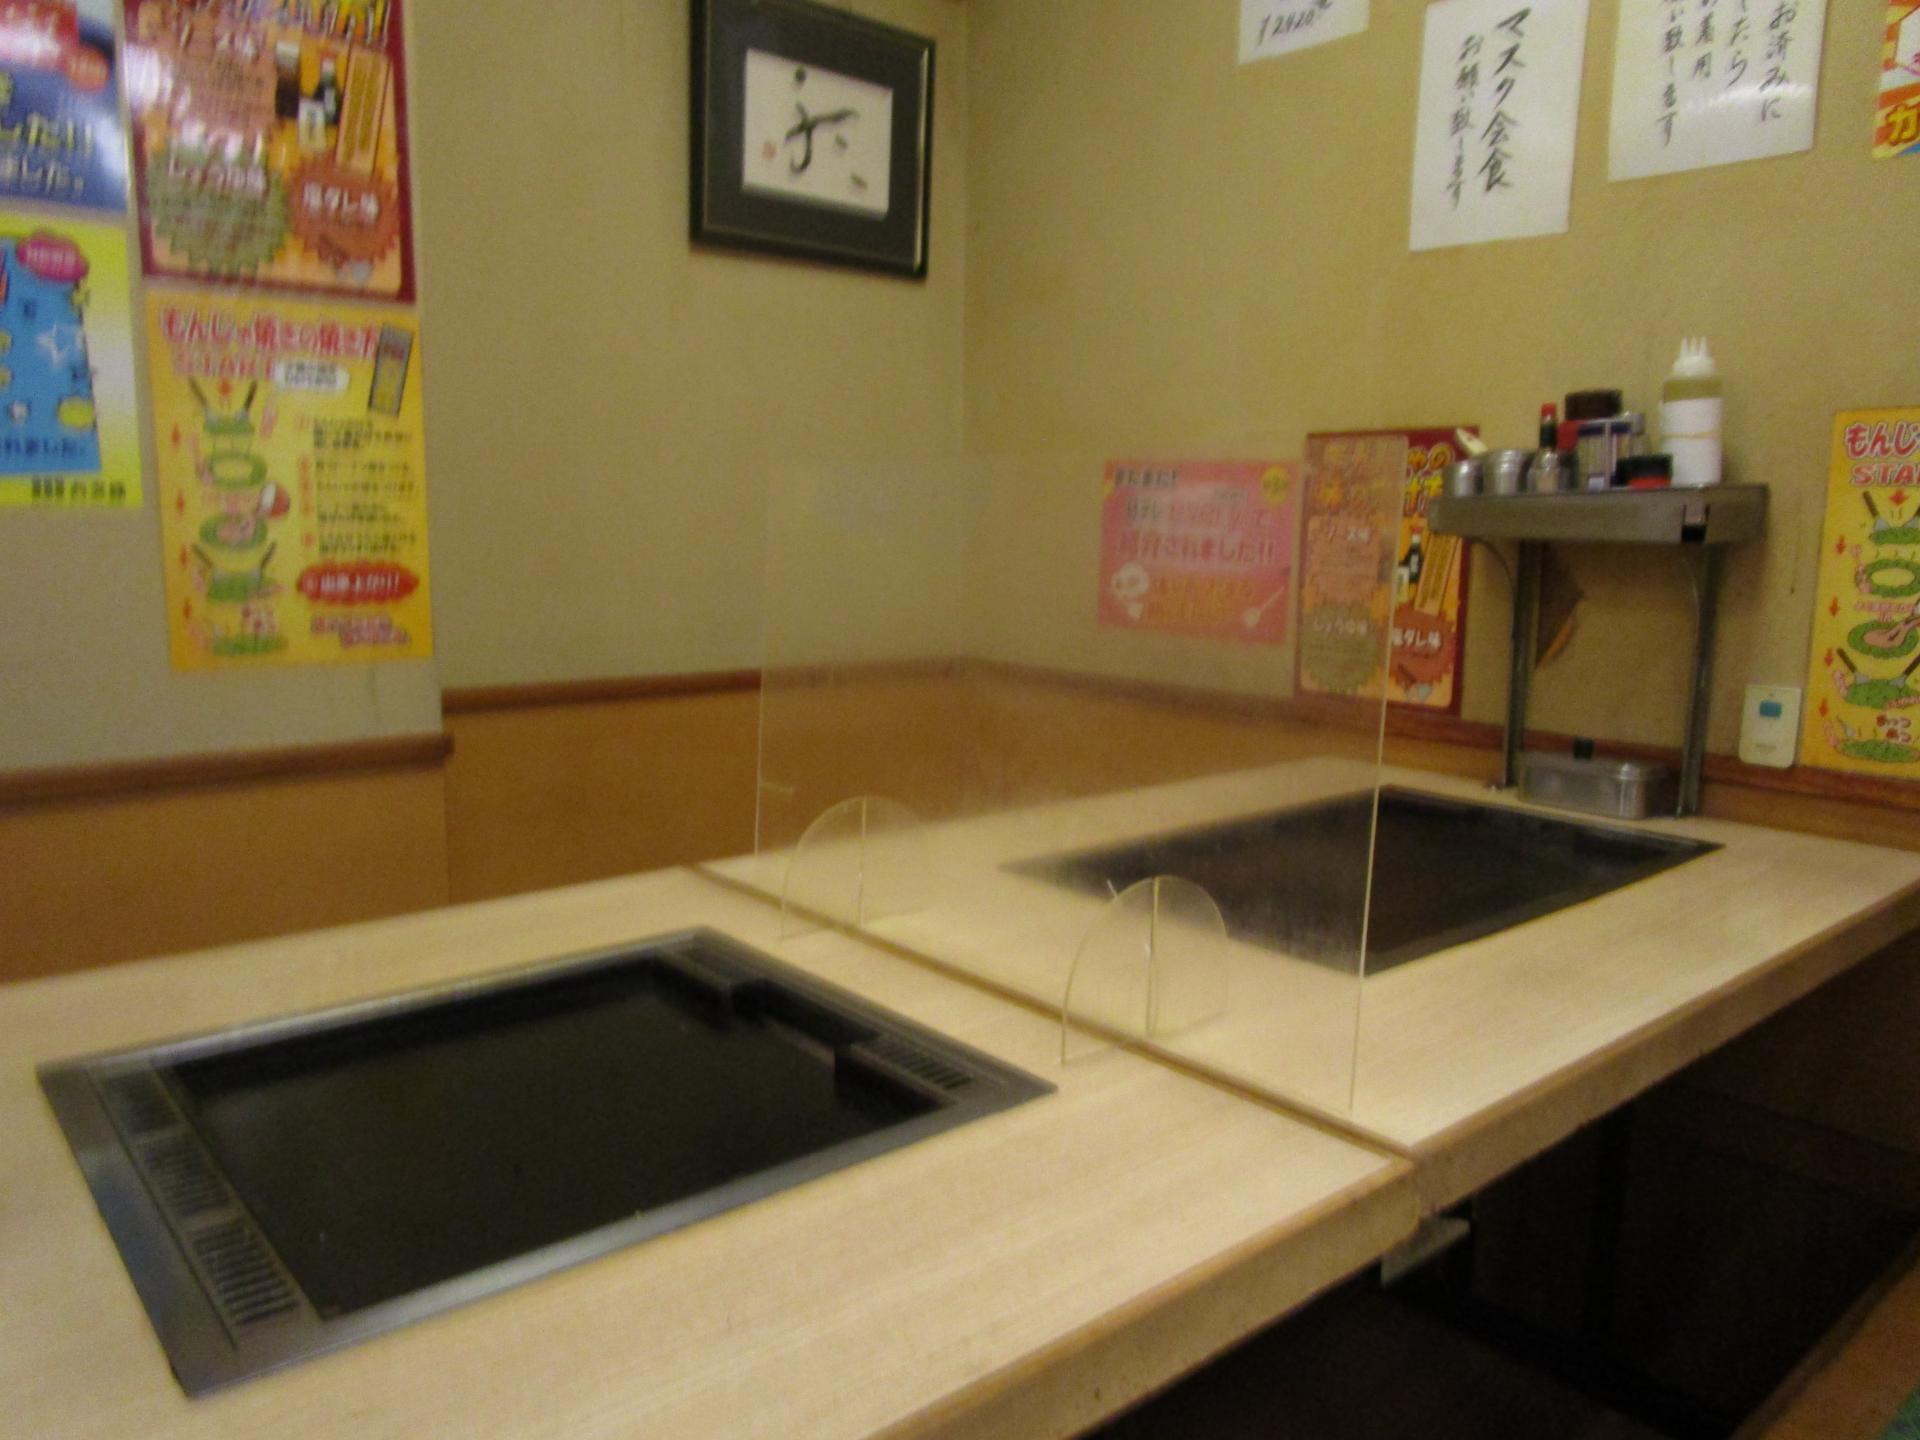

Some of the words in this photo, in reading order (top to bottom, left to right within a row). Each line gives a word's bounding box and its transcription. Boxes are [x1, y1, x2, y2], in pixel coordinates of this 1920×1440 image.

[1845, 421, 1920, 458] もんじ
[1853, 462, 1920, 487] STA
